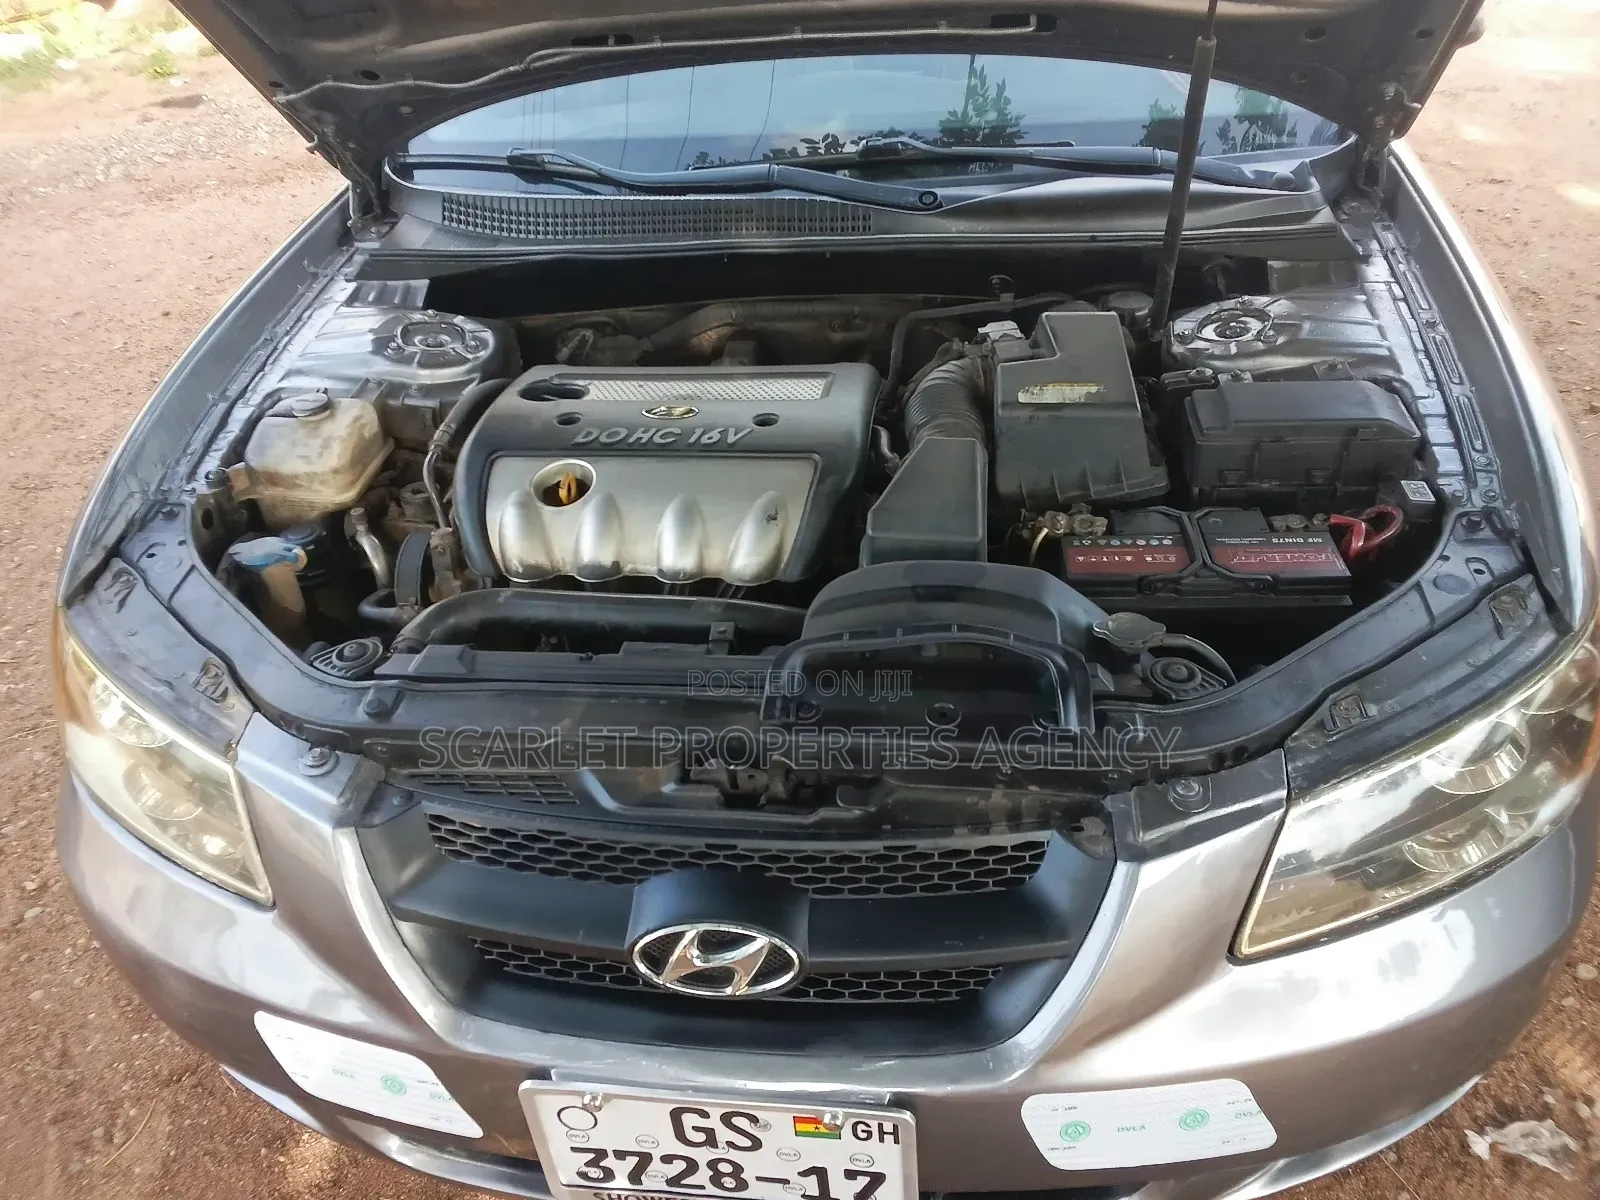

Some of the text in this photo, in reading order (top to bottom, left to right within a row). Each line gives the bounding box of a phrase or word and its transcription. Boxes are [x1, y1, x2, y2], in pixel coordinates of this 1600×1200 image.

[570, 426, 753, 446] DOHC 16V
[669, 1106, 763, 1152] GS
[851, 1120, 900, 1145] GH
[570, 1146, 887, 1200] 3728-17
